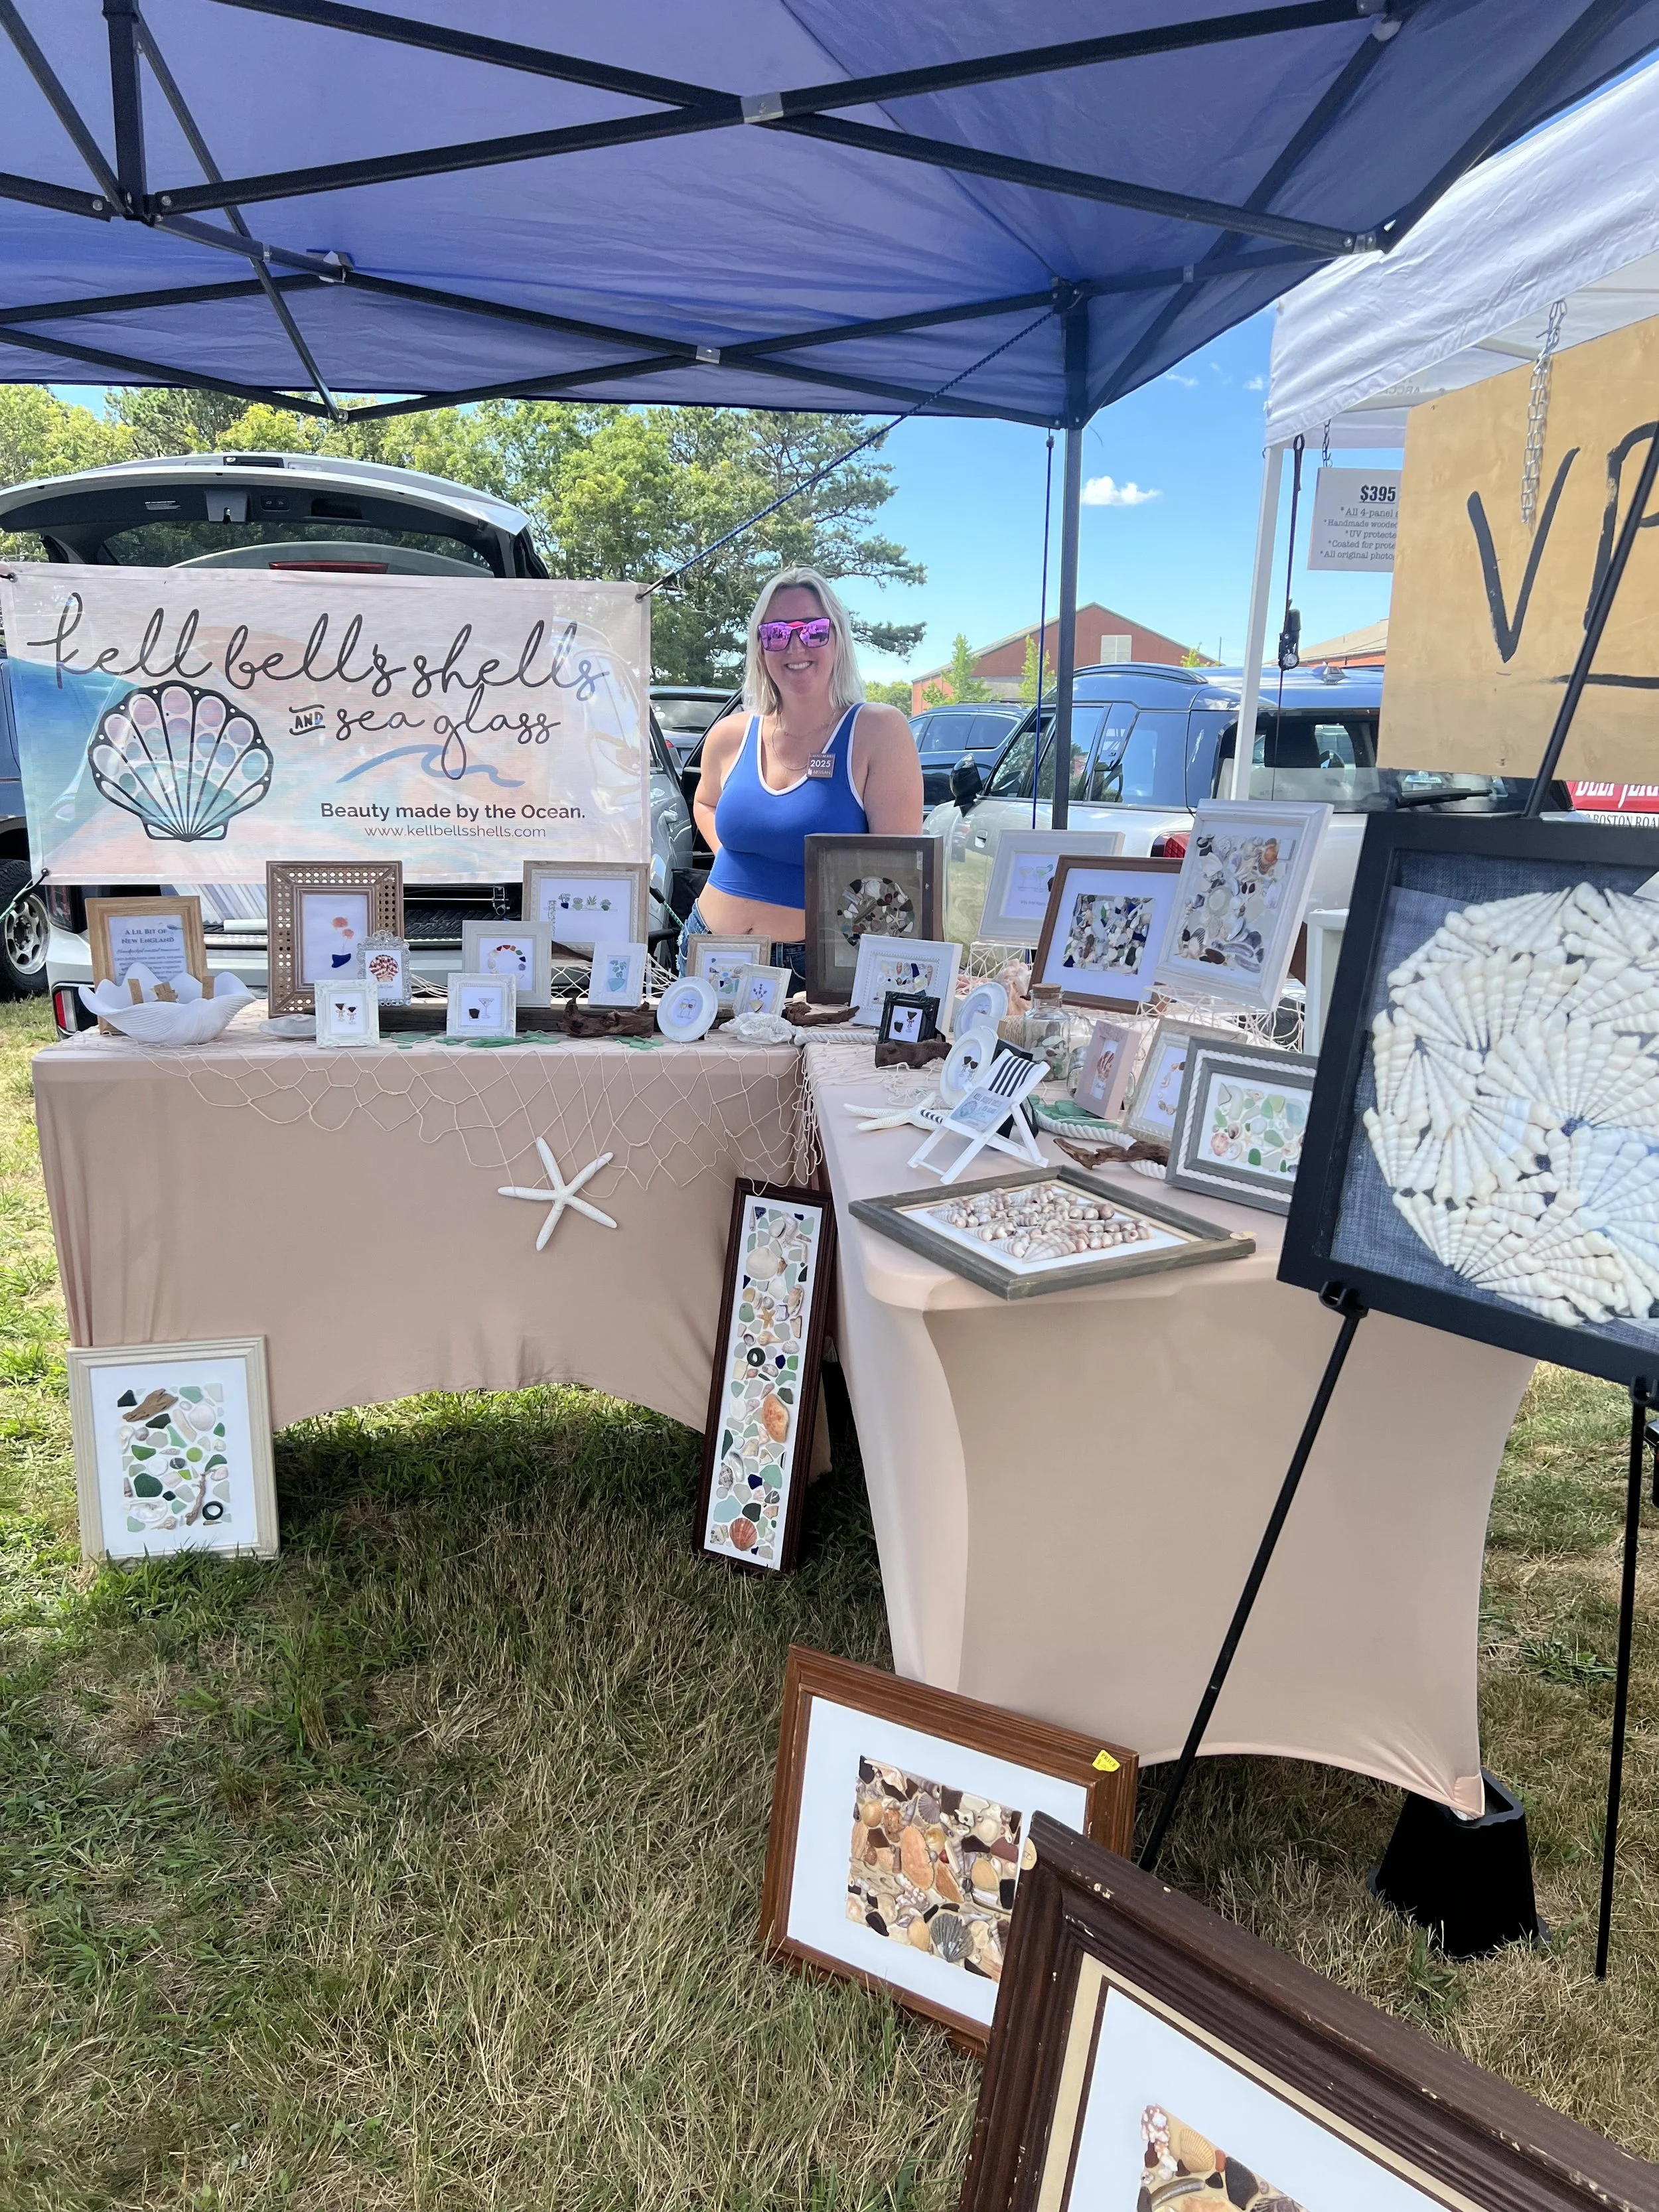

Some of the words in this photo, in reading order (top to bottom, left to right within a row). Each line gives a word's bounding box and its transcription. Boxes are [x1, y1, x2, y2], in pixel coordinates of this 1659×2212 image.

[1360, 484, 1396, 502] $395
[1360, 508, 1393, 518] 4-panel
[1337, 551, 1368, 559] original
[27, 592, 212, 690] kell
[225, 613, 406, 697] bell's
[412, 620, 609, 701] shells
[295, 711, 323, 729] AND
[336, 709, 425, 741] sea
[434, 683, 561, 780] glass
[810, 759, 831, 768] 2025
[321, 803, 390, 821] Beauty
[396, 804, 451, 818] made
[457, 804, 478, 822] by
[485, 804, 516, 818] the
[522, 804, 585, 818] Ocean.
[1593, 814, 1632, 827] BOSTON
[1636, 816, 1659, 828] ROA
[364, 825, 546, 837] www.kellbellsshells.com
